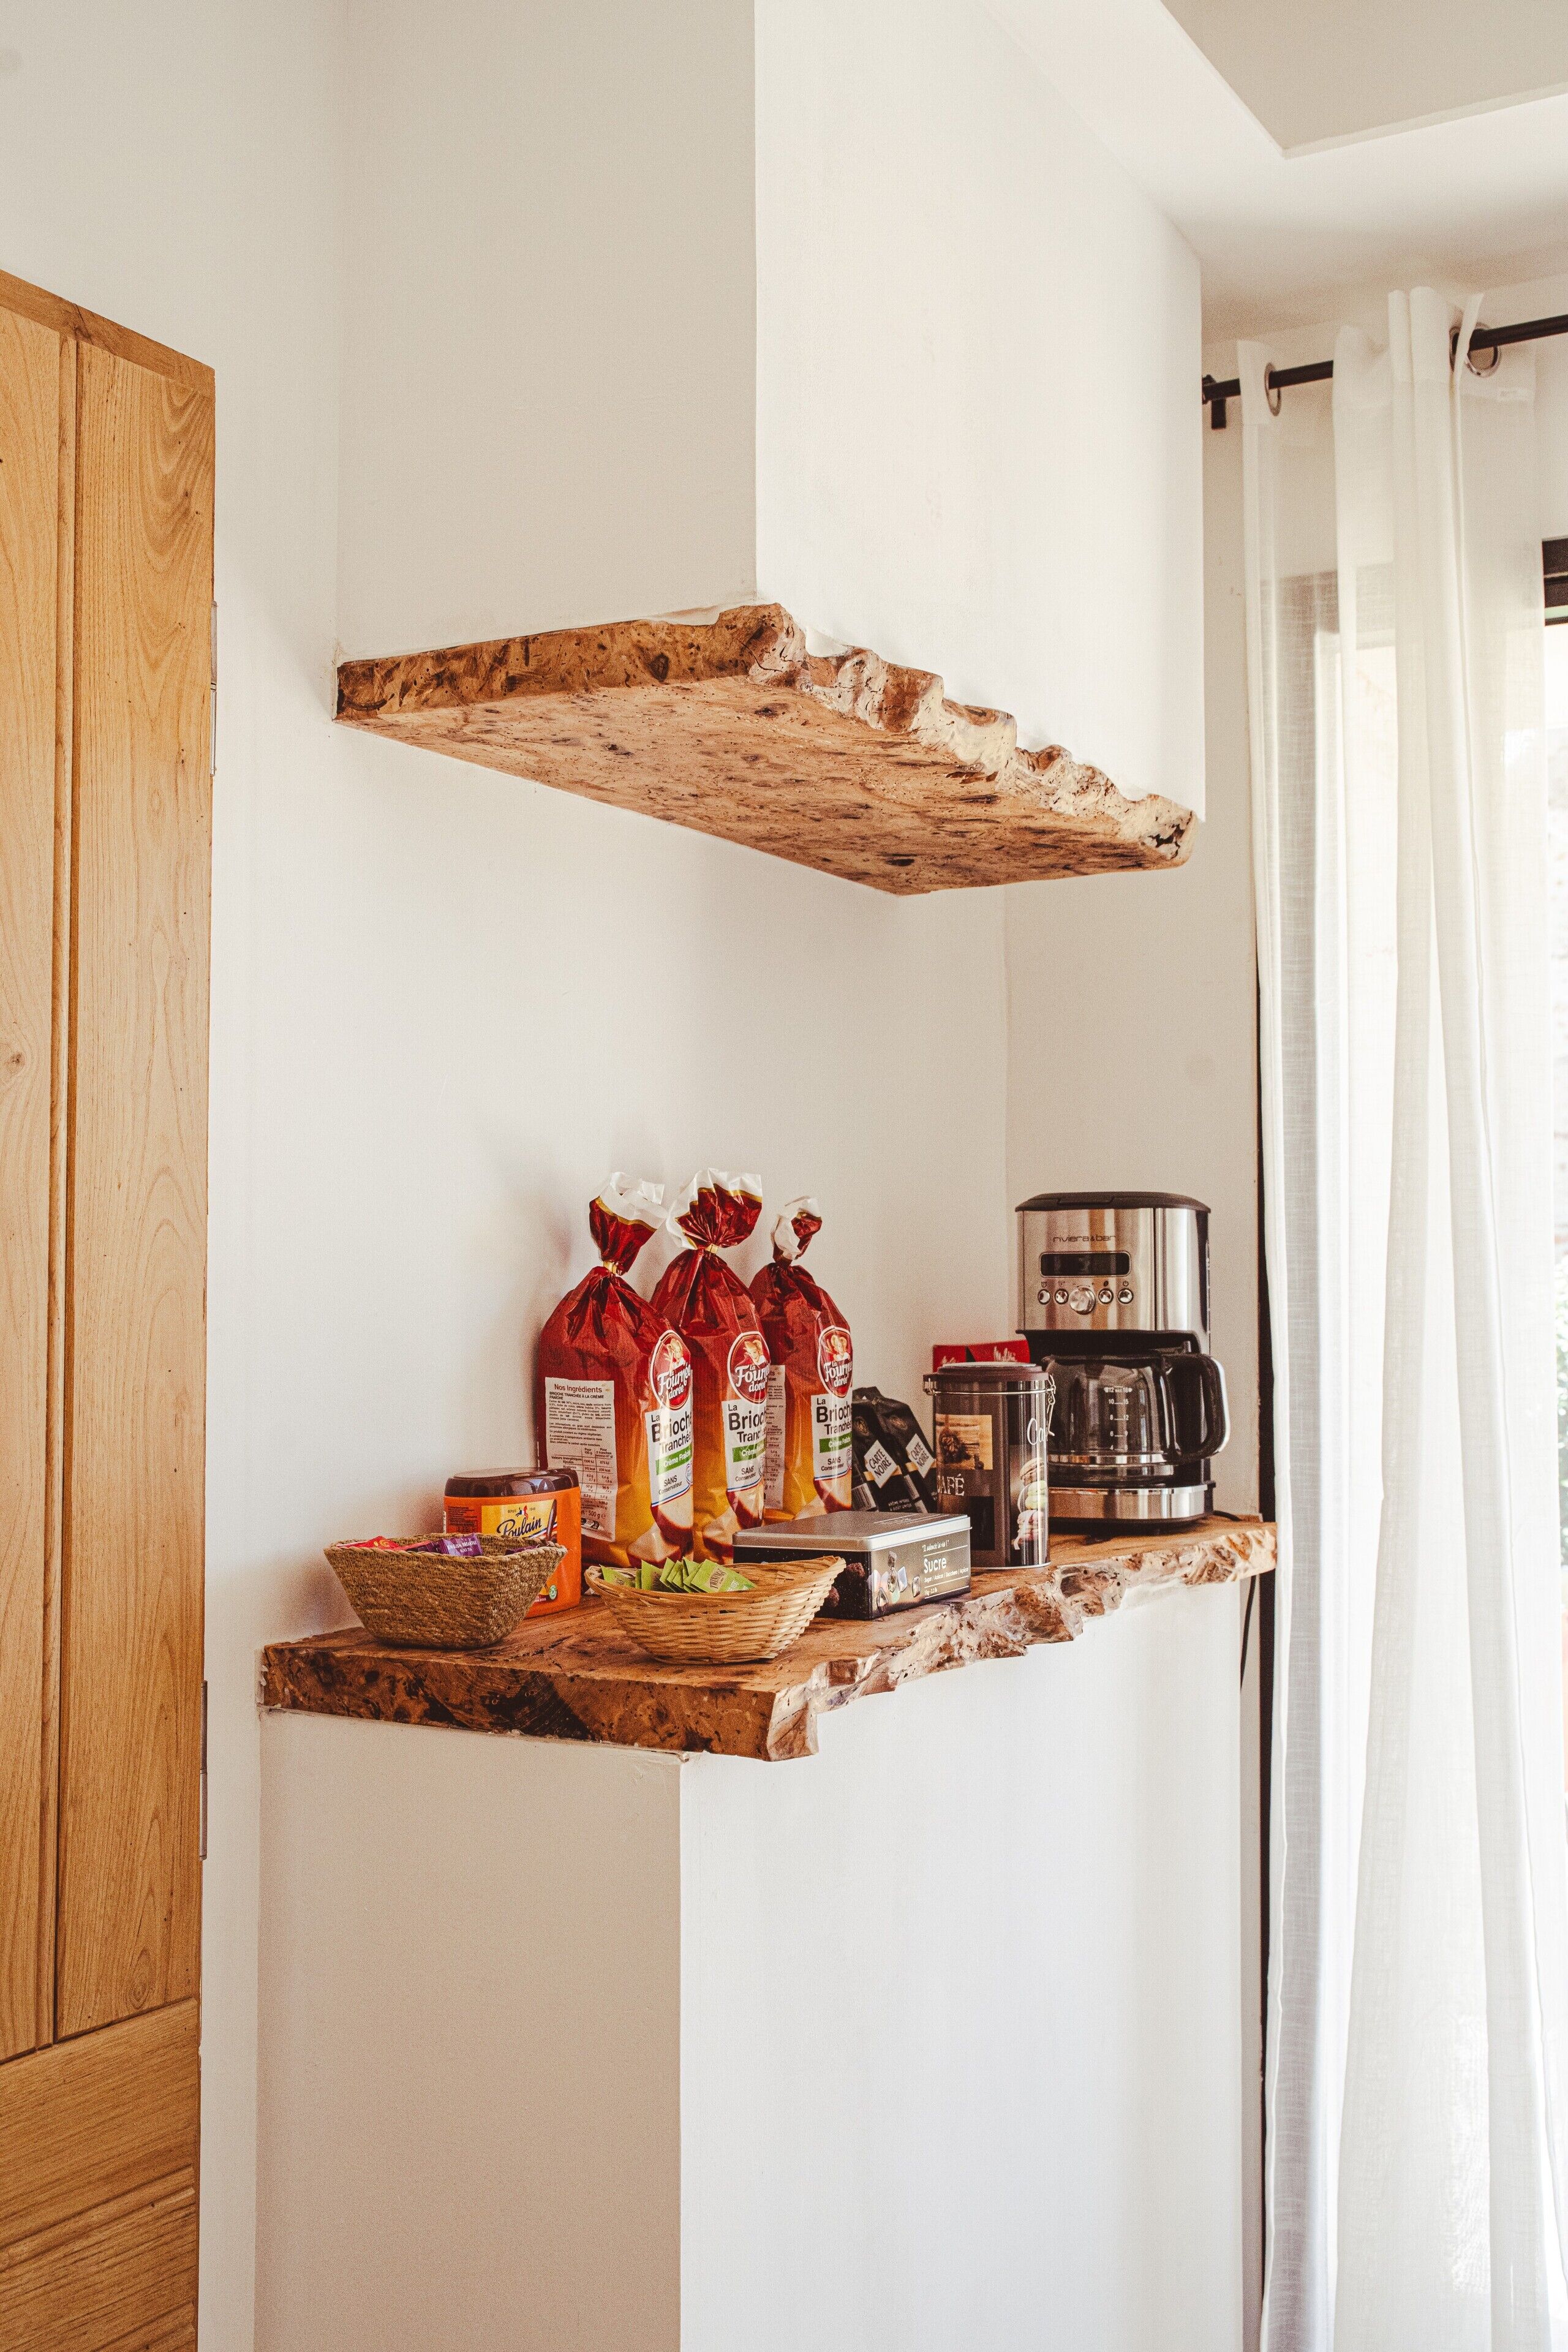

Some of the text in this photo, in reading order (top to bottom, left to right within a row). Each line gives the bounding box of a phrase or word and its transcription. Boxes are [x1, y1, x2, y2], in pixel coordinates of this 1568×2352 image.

[651, 1414, 660, 1423] La
[869, 1449, 885, 1469] CARTE
[911, 1442, 924, 1460] CARTE
[916, 1450, 929, 1468] NOIRE
[873, 1457, 892, 1477] NOIRE
[659, 1481, 682, 1495] Conservateur
[664, 1475, 677, 1487] SANS
[496, 1516, 542, 1537] Poulain
[924, 1558, 947, 1574] Sucre
